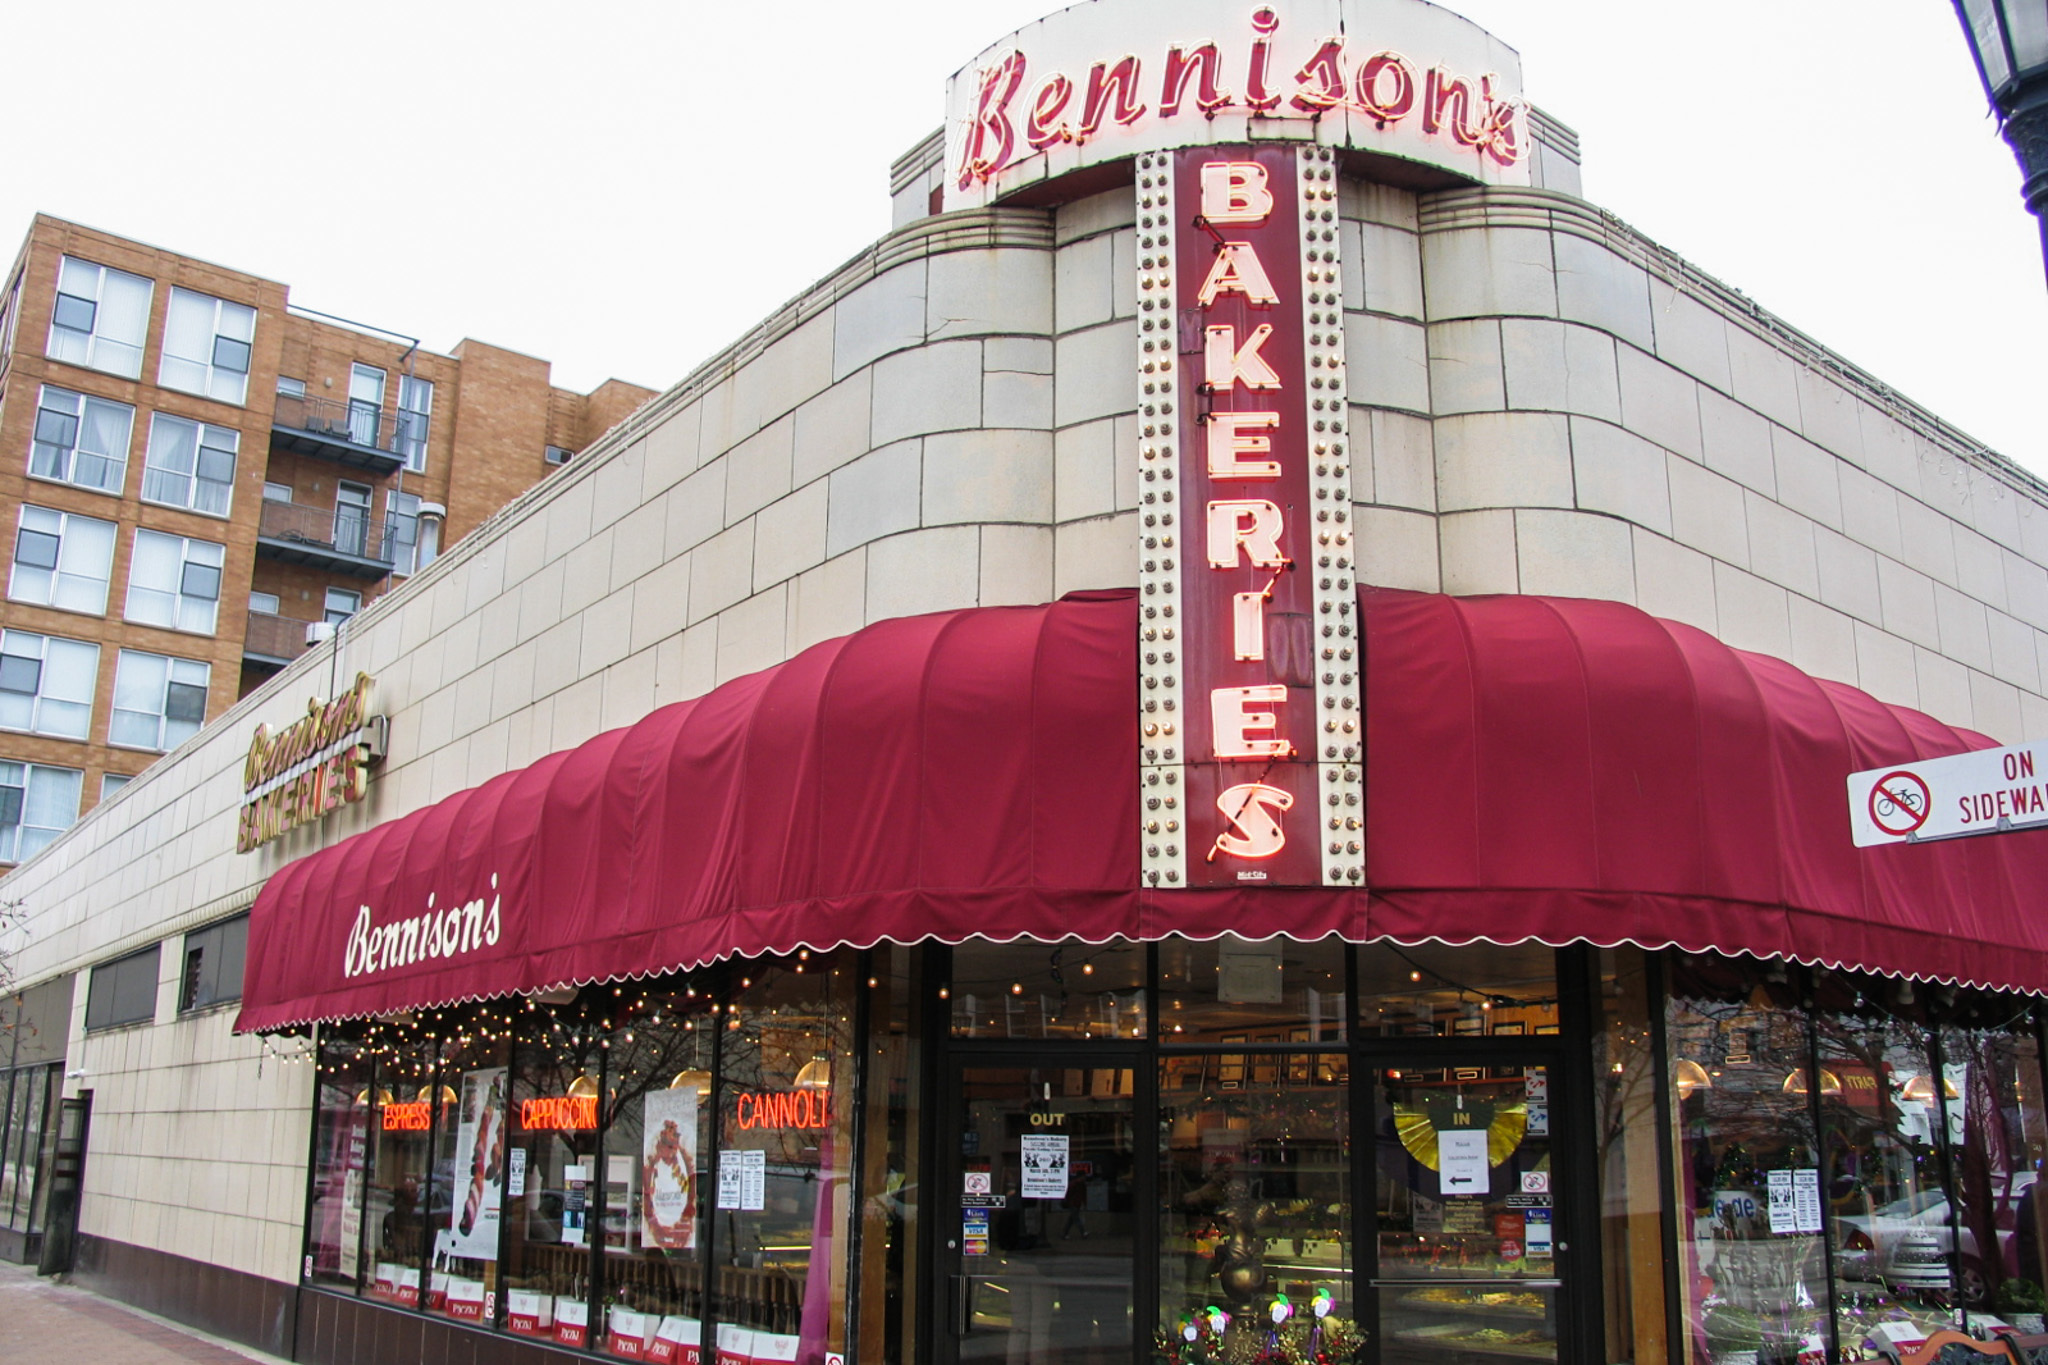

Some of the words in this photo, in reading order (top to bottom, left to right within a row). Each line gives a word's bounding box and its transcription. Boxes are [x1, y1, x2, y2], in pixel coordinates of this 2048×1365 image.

[1198, 160, 1294, 859] BAKERIES
[2003, 750, 2034, 781] ON
[344, 871, 501, 979] Bennison's
[737, 1088, 827, 1130] CANNOLI
[1029, 1112, 1065, 1127] OUT
[1453, 1113, 1471, 1126] IN
